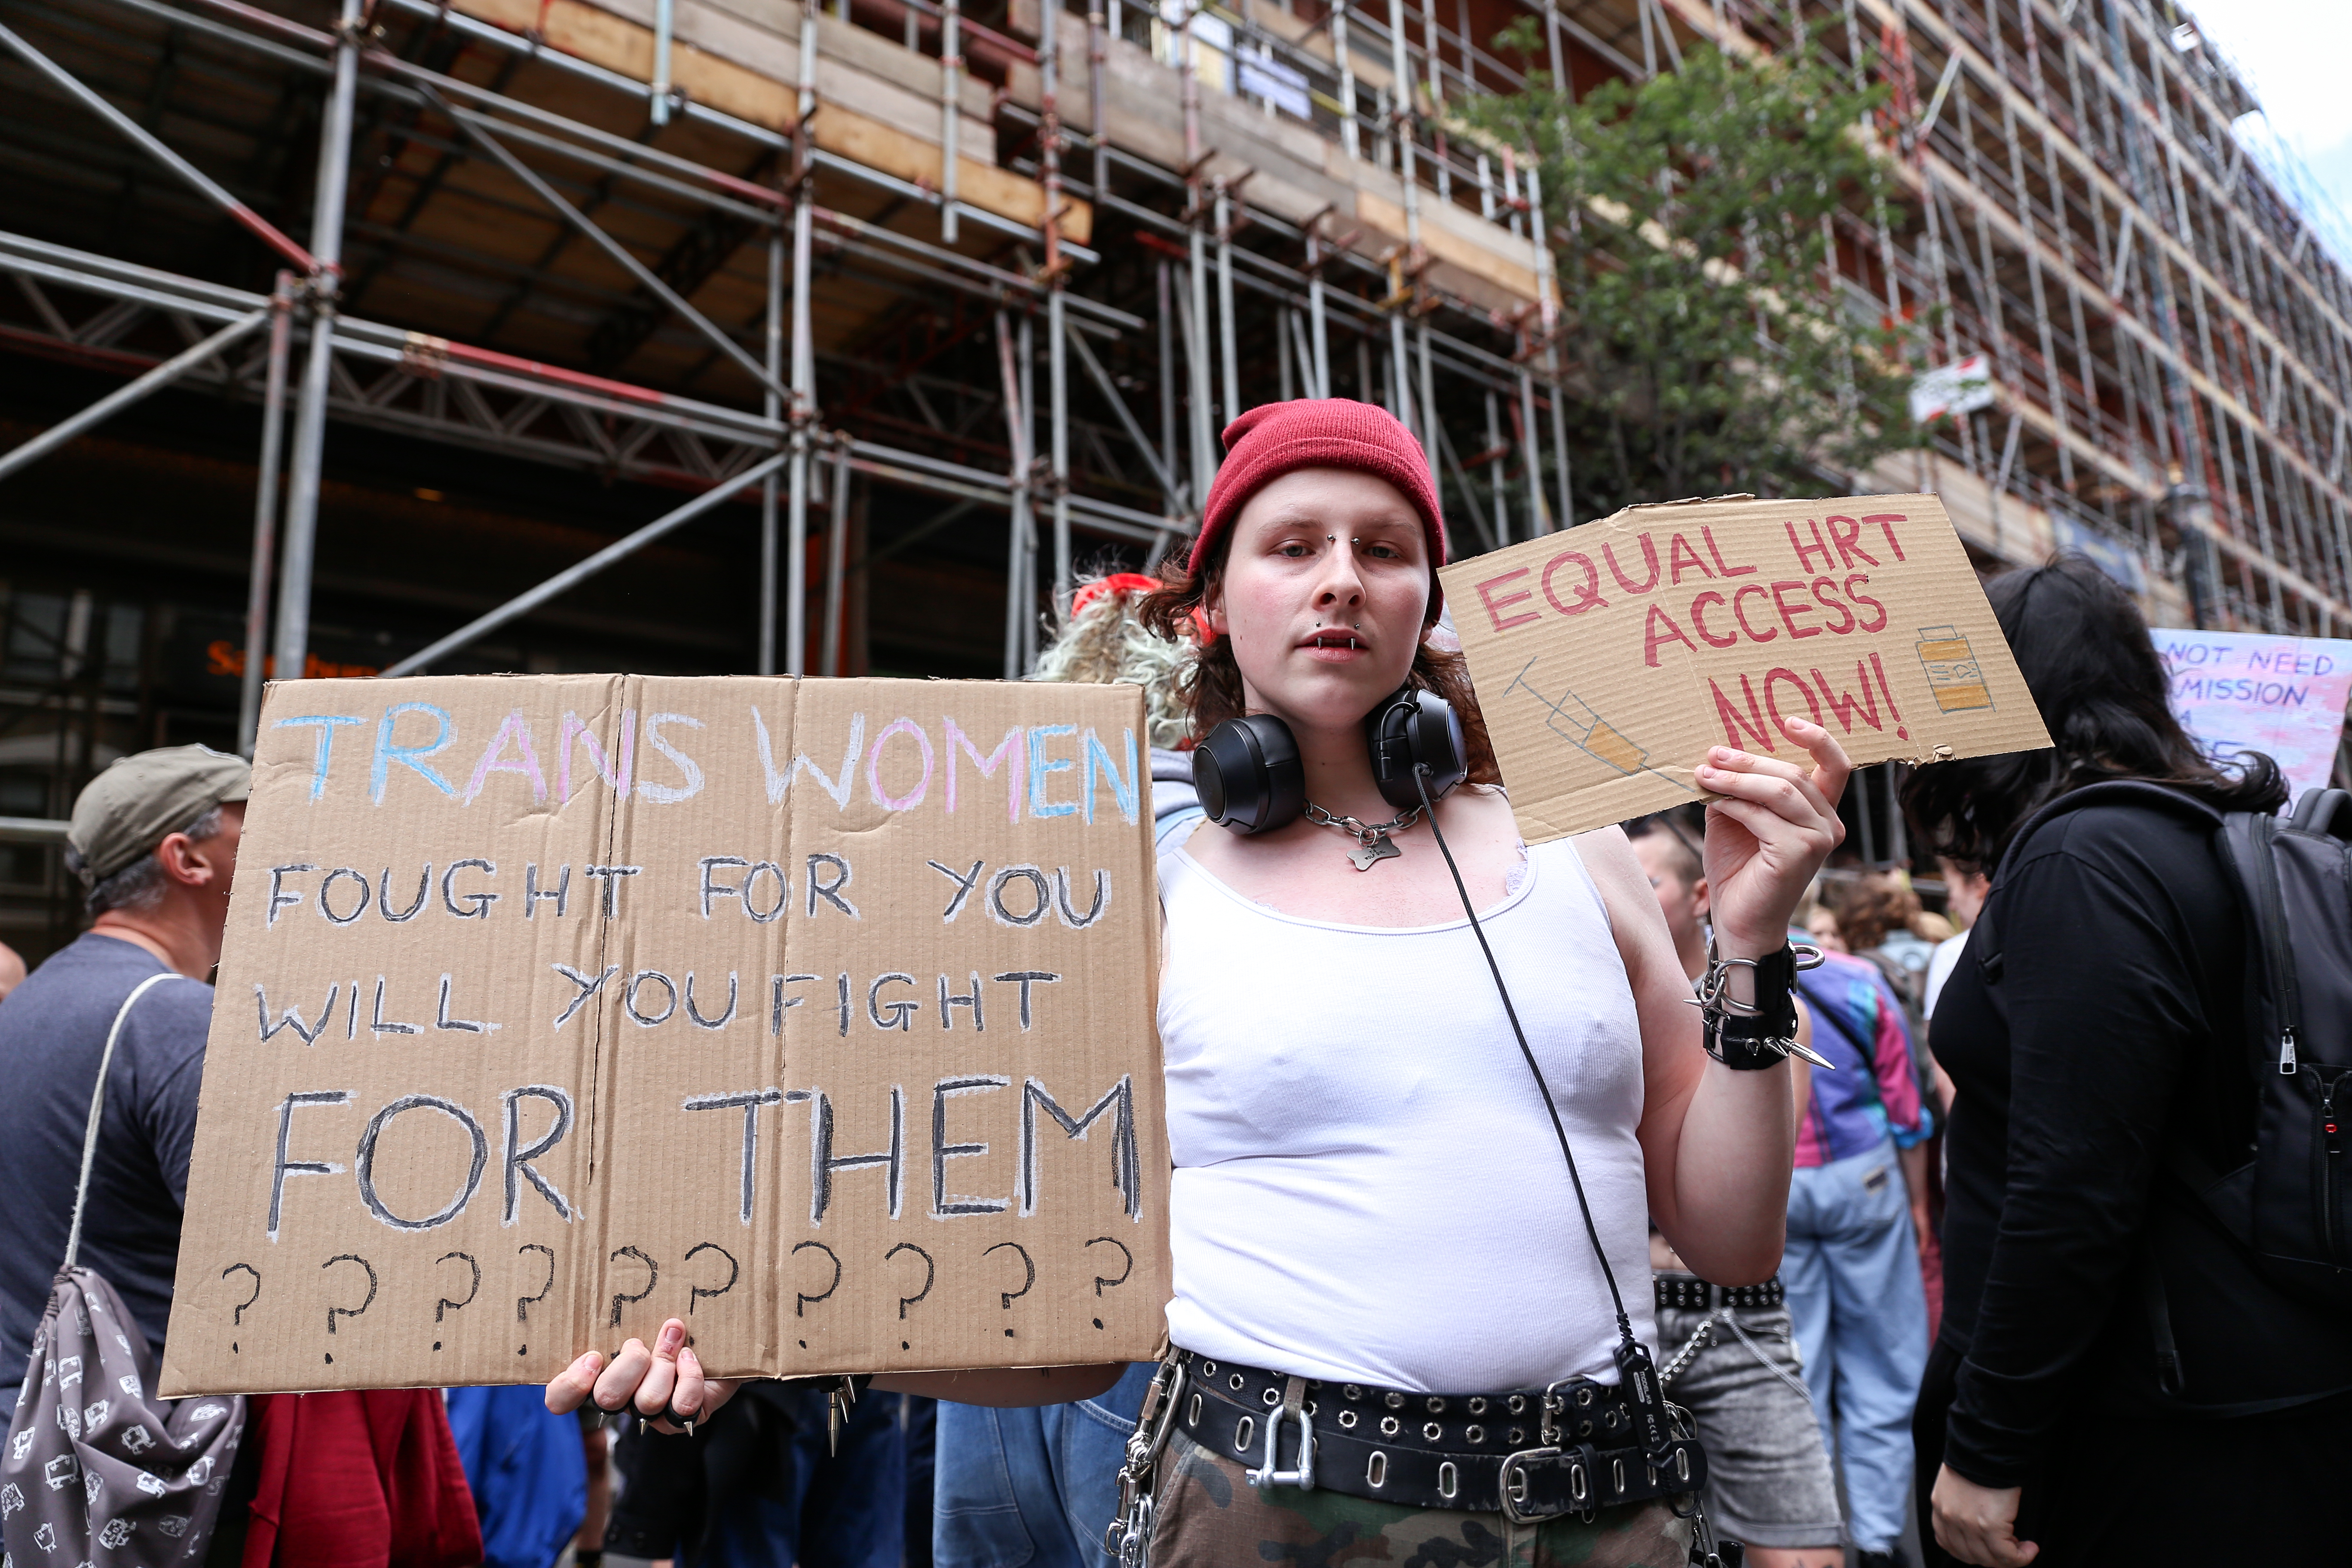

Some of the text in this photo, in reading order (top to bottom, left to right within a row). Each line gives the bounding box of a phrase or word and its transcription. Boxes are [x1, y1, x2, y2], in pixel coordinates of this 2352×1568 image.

[1475, 514, 1907, 633] EQUAL HRT
[1643, 573, 1888, 668] ACCESS
[1708, 652, 1908, 754] NOW!
[2167, 642, 2334, 676] NOT NEED
[272, 702, 1138, 825] TRANS WOMEN
[267, 852, 1112, 930] FOUGHT FOR YOU
[254, 962, 1061, 1046] WILL YOU FIGHT
[266, 1073, 1143, 1243] FOR THEM
